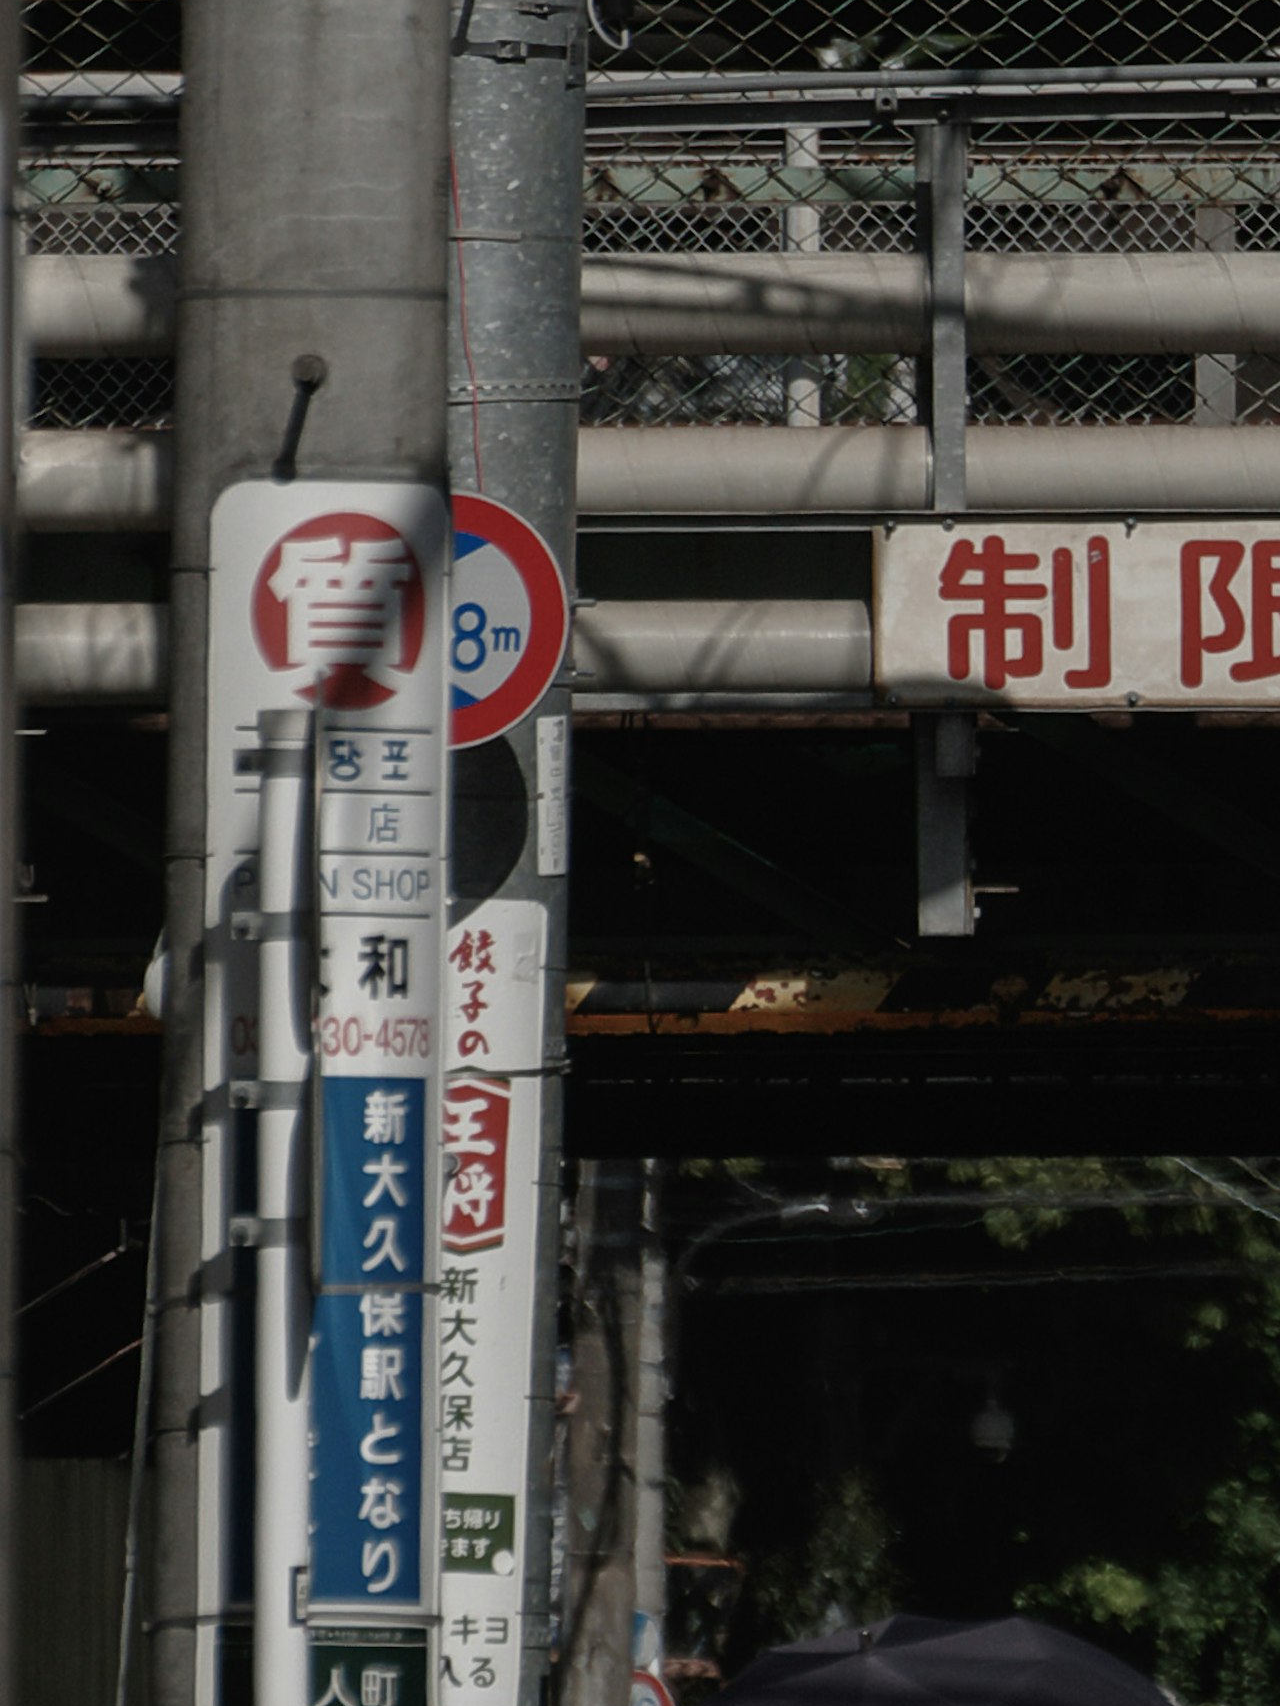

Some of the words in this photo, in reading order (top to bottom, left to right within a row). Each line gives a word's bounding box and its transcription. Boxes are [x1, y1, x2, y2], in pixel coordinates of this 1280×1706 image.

[453, 602, 521, 673] 8m
[327, 739, 409, 782] 당포
[367, 802, 402, 844] 店
[352, 868, 431, 902] SHOP
[448, 929, 496, 1059] 餃子の
[443, 1097, 497, 1229] 王将
[358, 1090, 408, 1595] 新大久保駅となり
[442, 1508, 501, 1530] ち帰り
[449, 1614, 509, 1646] キヨ
